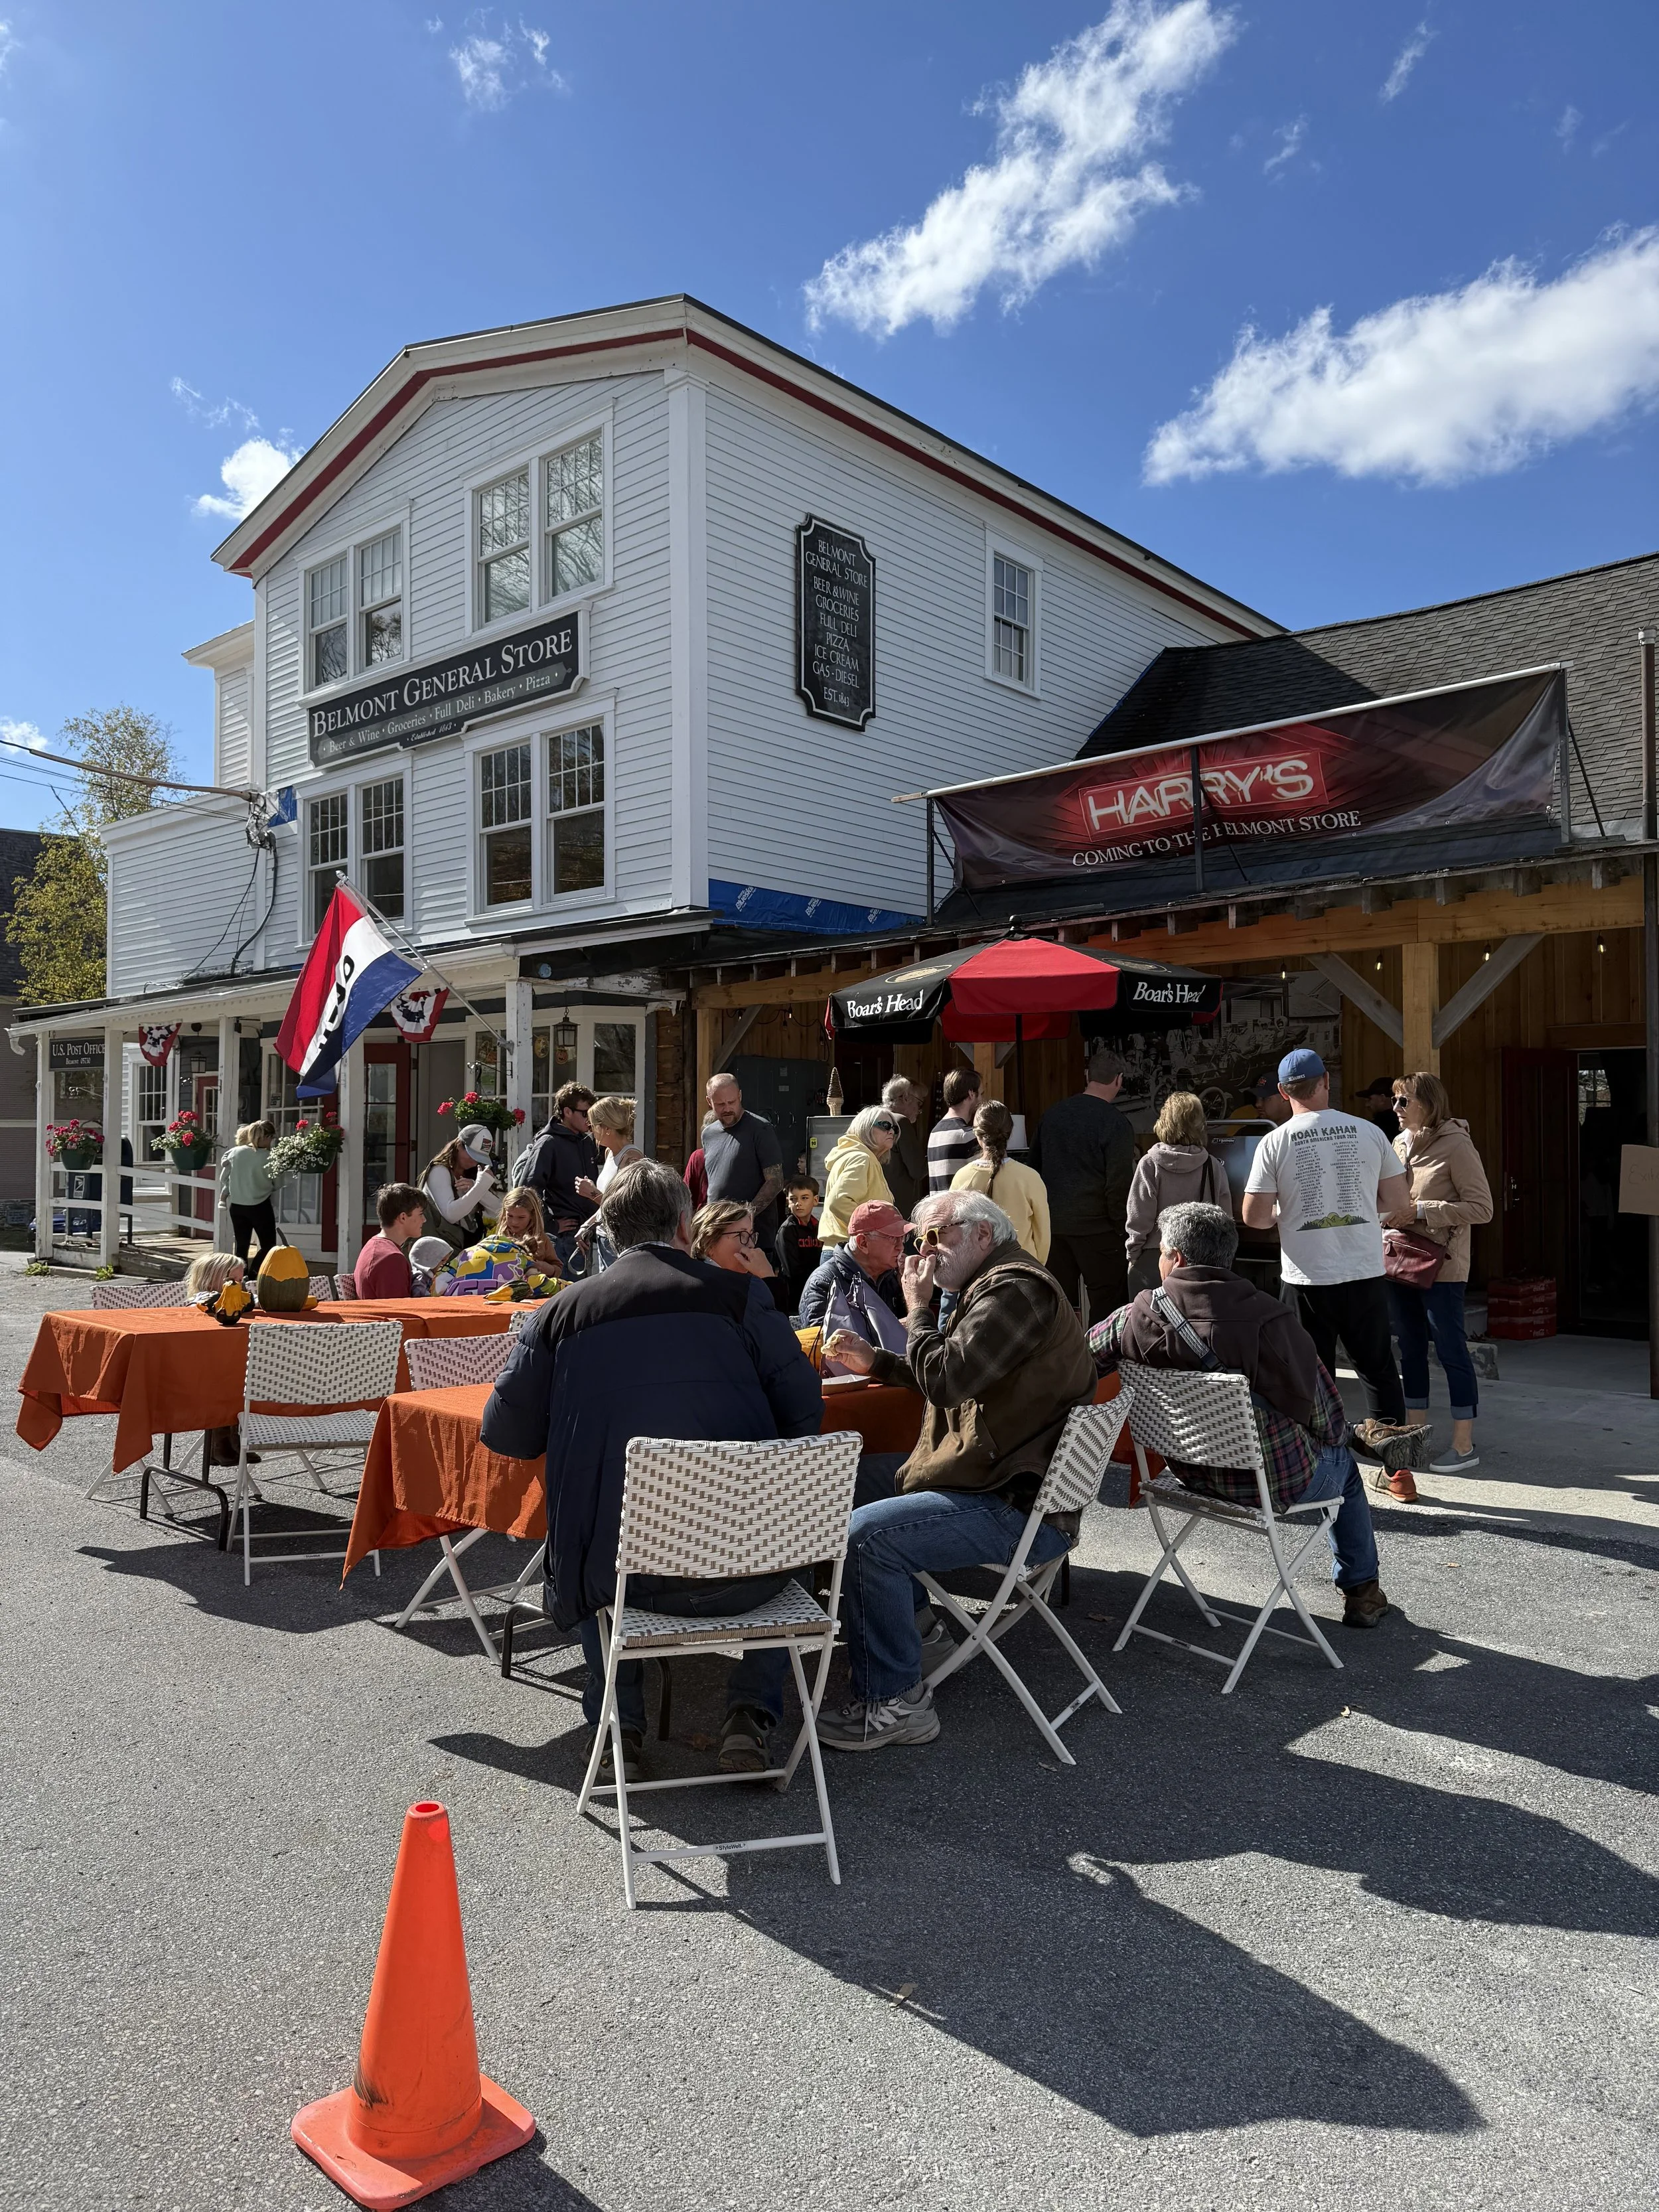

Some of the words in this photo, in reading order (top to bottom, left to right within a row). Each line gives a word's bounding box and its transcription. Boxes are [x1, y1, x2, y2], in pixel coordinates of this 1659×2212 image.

[818, 540, 856, 566] BELMONT
[806, 552, 841, 577] GENERAL
[845, 568, 867, 588] STORE
[814, 576, 831, 595] BEER
[816, 595, 859, 621] GROCERIES
[820, 612, 837, 631] FULL
[841, 621, 857, 637] DELI
[826, 632, 849, 652] PIZZA
[814, 644, 827, 660] ICE
[830, 650, 859, 672] CREAM
[312, 690, 399, 737] BELMONT
[403, 656, 497, 707] GENERAL
[501, 629, 573, 674] STORE
[812, 661, 830, 678] GAS
[835, 669, 860, 688] DIESEL
[329, 738, 347, 753] Beer
[348, 735, 355, 747] &
[358, 729, 380, 745] Wine
[388, 715, 427, 735] Groceries
[435, 704, 451, 720] Full
[457, 697, 475, 712] Deli
[484, 686, 516, 704] Bakery
[526, 676, 551, 692] Pizza
[411, 728, 437, 741] Established
[1088, 759, 1314, 830] HARRY'S
[1072, 842, 1143, 866] COMING
[1143, 837, 1171, 854] TO
[1300, 810, 1361, 831] STORE
[847, 996, 882, 1019] Boar's
[886, 990, 923, 1013] Head
[1133, 982, 1173, 1003] Boar's
[52, 1043, 65, 1056] U.S.
[67, 1043, 82, 1055] POST
[84, 1042, 106, 1055] OFFICE
[1291, 1128, 1318, 1142] NOAH
[1321, 1125, 1357, 1136] KAHAN
